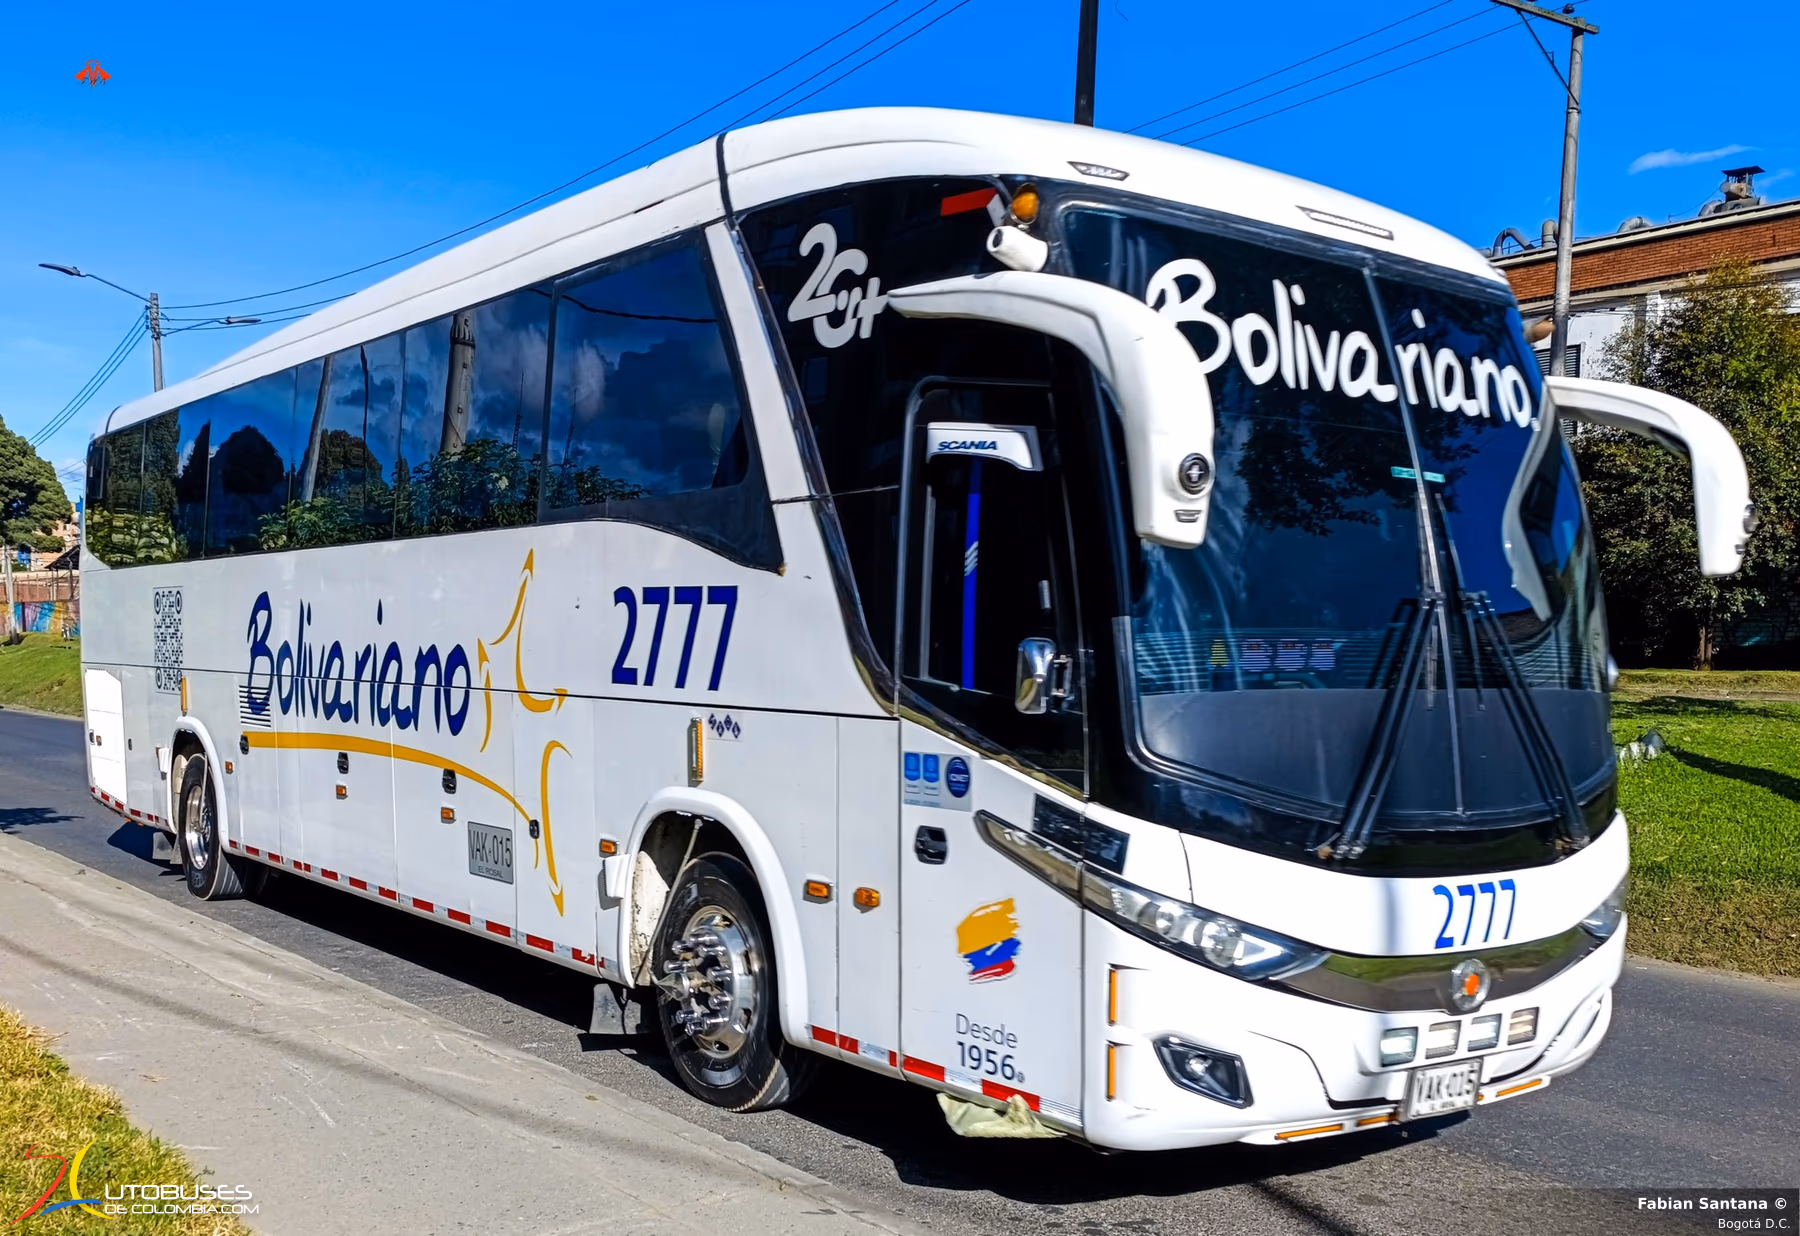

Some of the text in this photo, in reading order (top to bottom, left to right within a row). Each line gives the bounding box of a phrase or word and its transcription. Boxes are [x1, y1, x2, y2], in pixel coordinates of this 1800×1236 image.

[1145, 258, 1532, 428] Bolivariano
[937, 440, 998, 451] SCANIA
[246, 591, 472, 737] Bolivariano
[611, 585, 739, 692] 2777
[1432, 878, 1516, 950] 2777
[955, 1012, 1019, 1049] Desde
